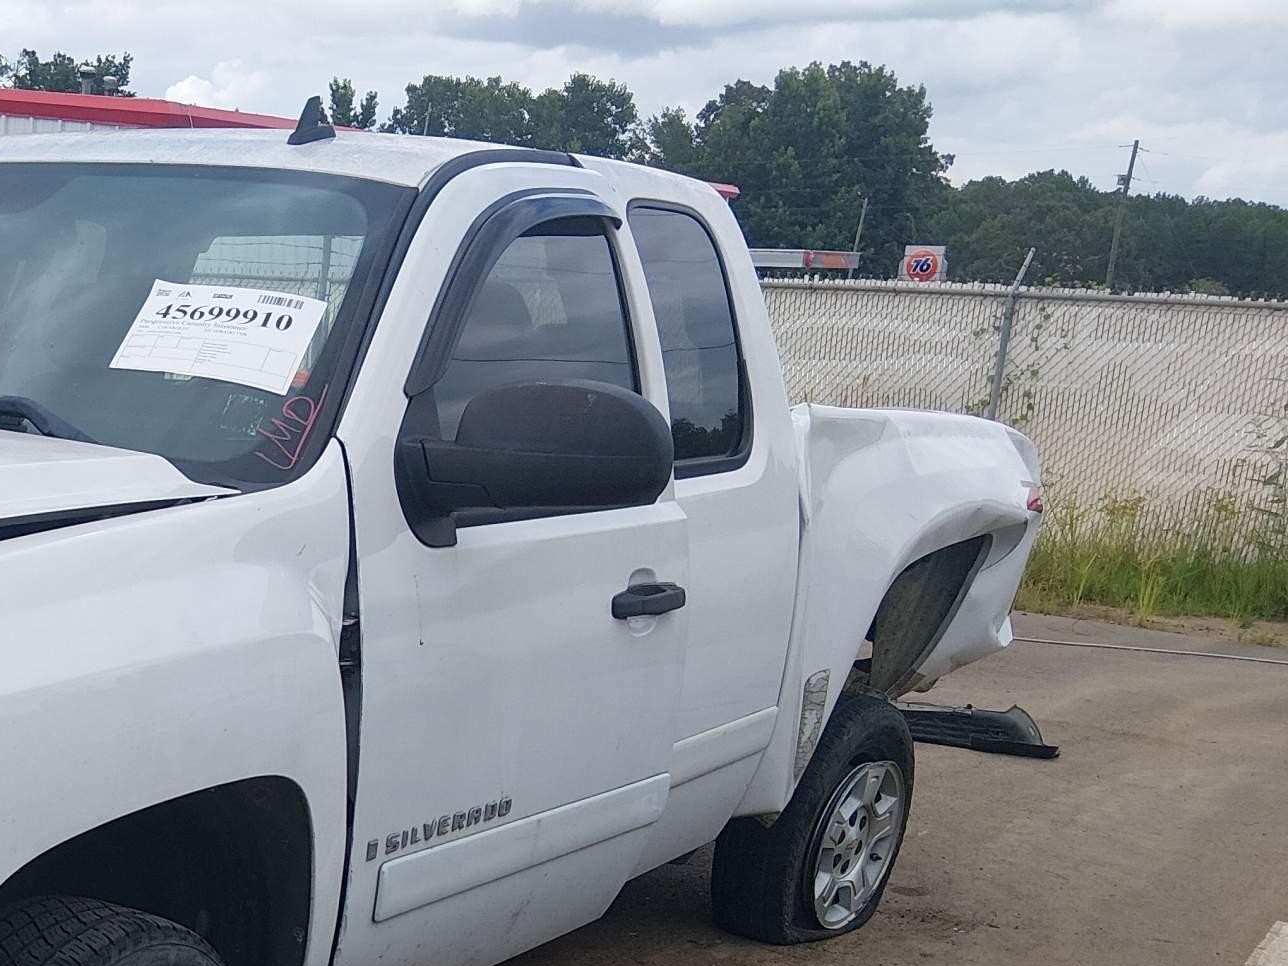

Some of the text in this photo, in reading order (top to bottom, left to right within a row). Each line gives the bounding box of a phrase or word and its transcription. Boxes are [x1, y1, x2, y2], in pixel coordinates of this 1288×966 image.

[911, 257, 933, 274] 76
[155, 303, 293, 331] 45699910
[384, 797, 513, 855] SILVERADO
